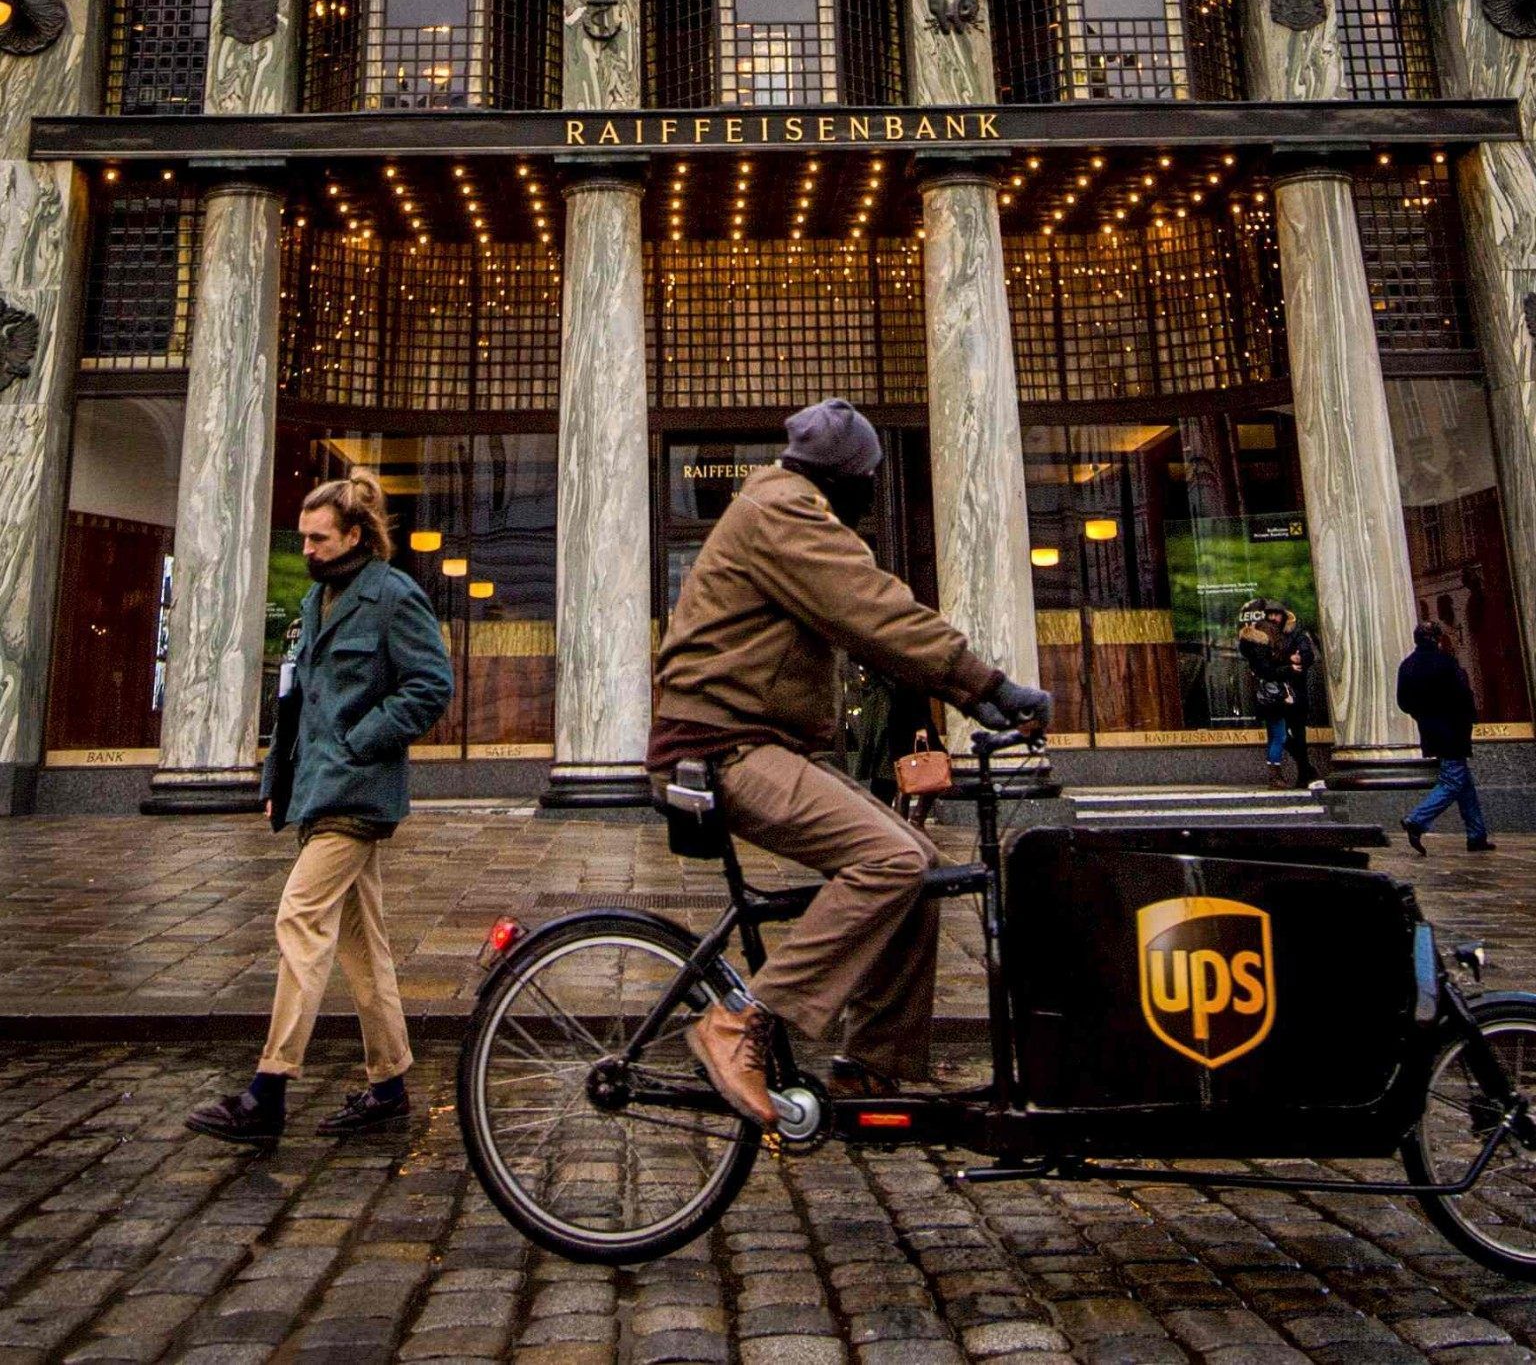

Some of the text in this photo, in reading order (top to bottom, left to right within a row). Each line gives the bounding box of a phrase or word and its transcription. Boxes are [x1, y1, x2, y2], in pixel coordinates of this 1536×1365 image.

[565, 114, 1000, 145] RAIFFEISENBANK
[1144, 730, 1249, 744] RAIFFEISENBANK
[87, 751, 126, 763] BANK
[1150, 949, 1265, 1039] ups
